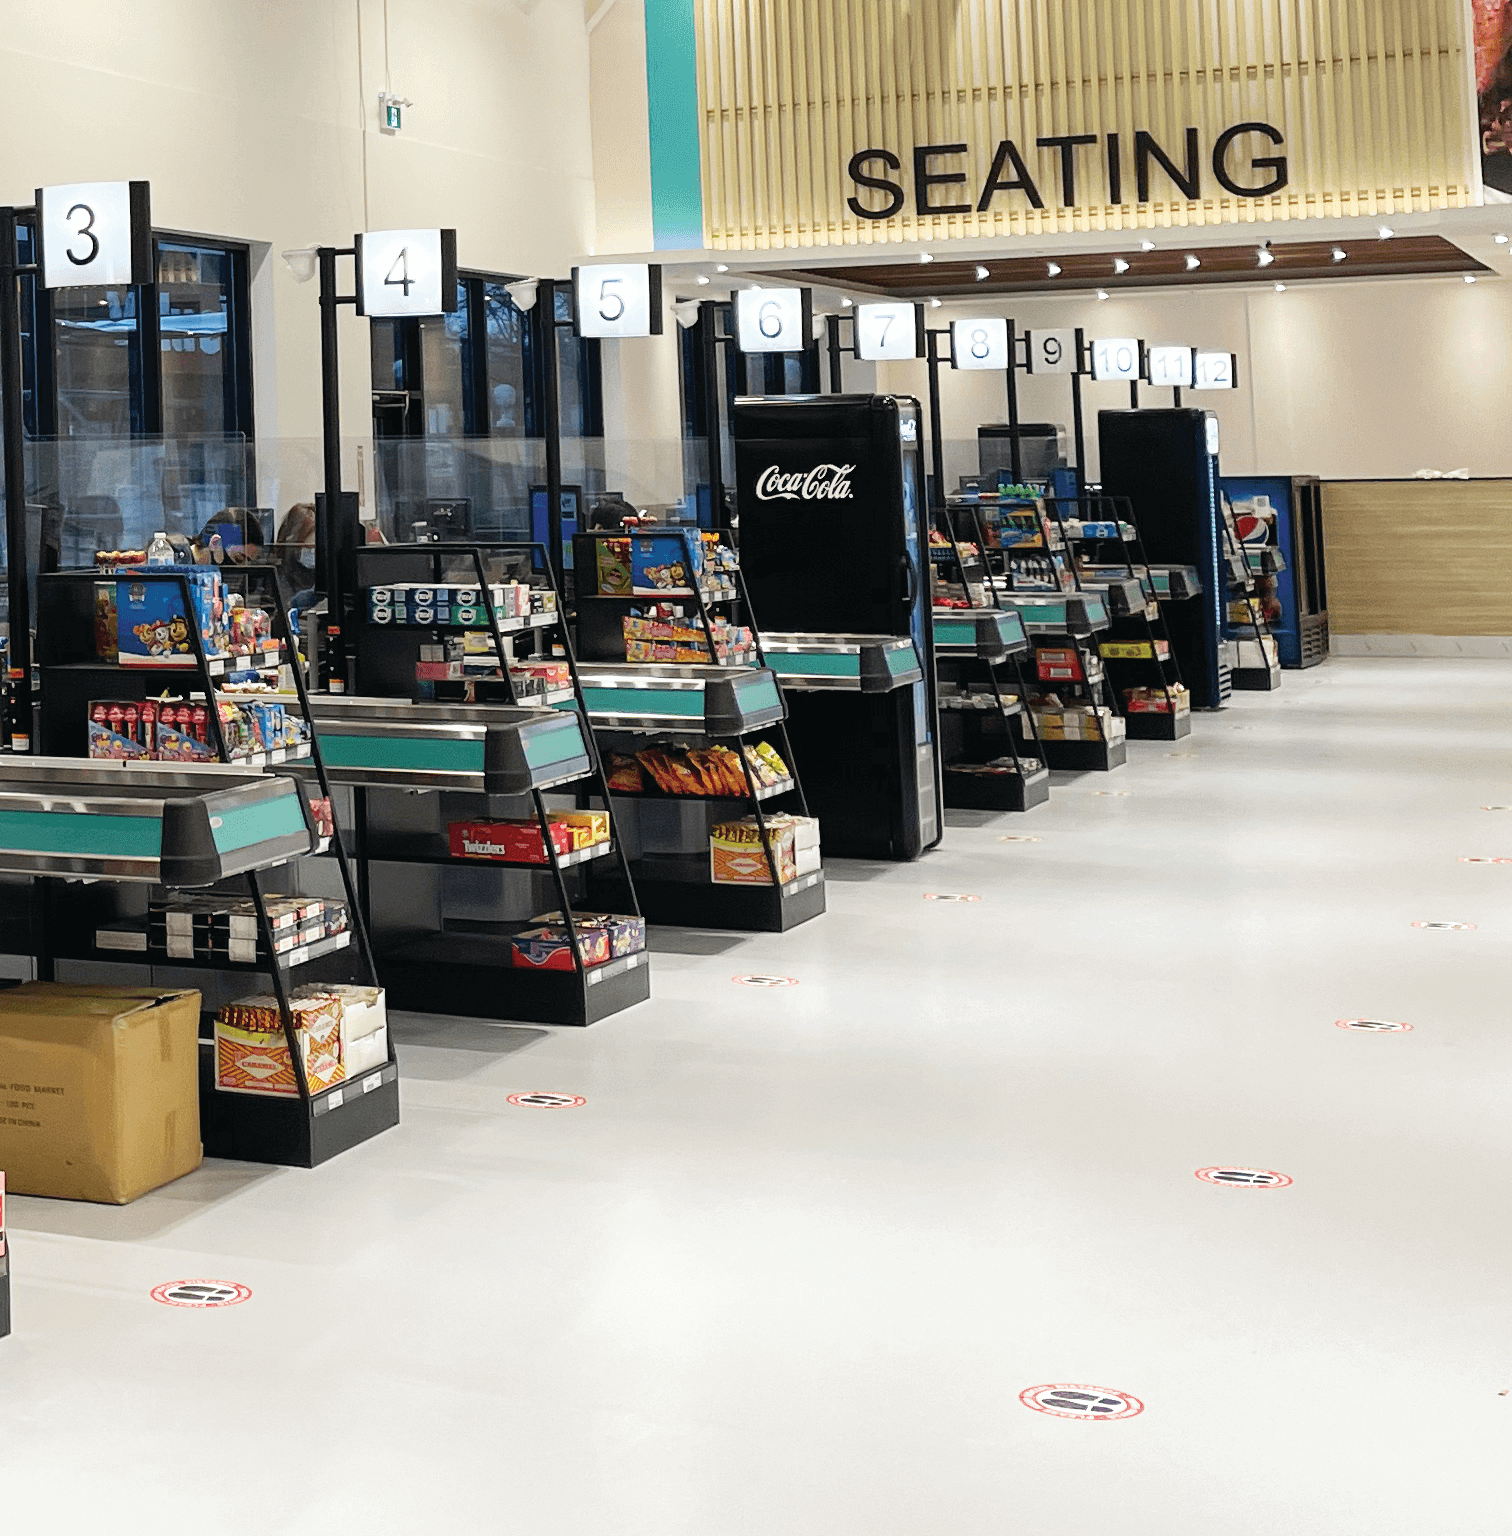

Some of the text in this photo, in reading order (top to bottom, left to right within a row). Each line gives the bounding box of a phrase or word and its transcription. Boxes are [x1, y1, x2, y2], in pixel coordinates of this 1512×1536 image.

[846, 121, 1289, 220] SEATING
[65, 203, 100, 266] 3
[384, 246, 416, 297] 4
[598, 278, 625, 322] 5
[758, 301, 783, 339] 6
[874, 314, 896, 348] 7
[970, 328, 990, 360] 8
[1043, 337, 1062, 365] 9
[1098, 346, 1134, 373] 10
[1156, 354, 1184, 379] 11
[1199, 360, 1229, 383] 12
[755, 463, 857, 501] Coca-Cola
